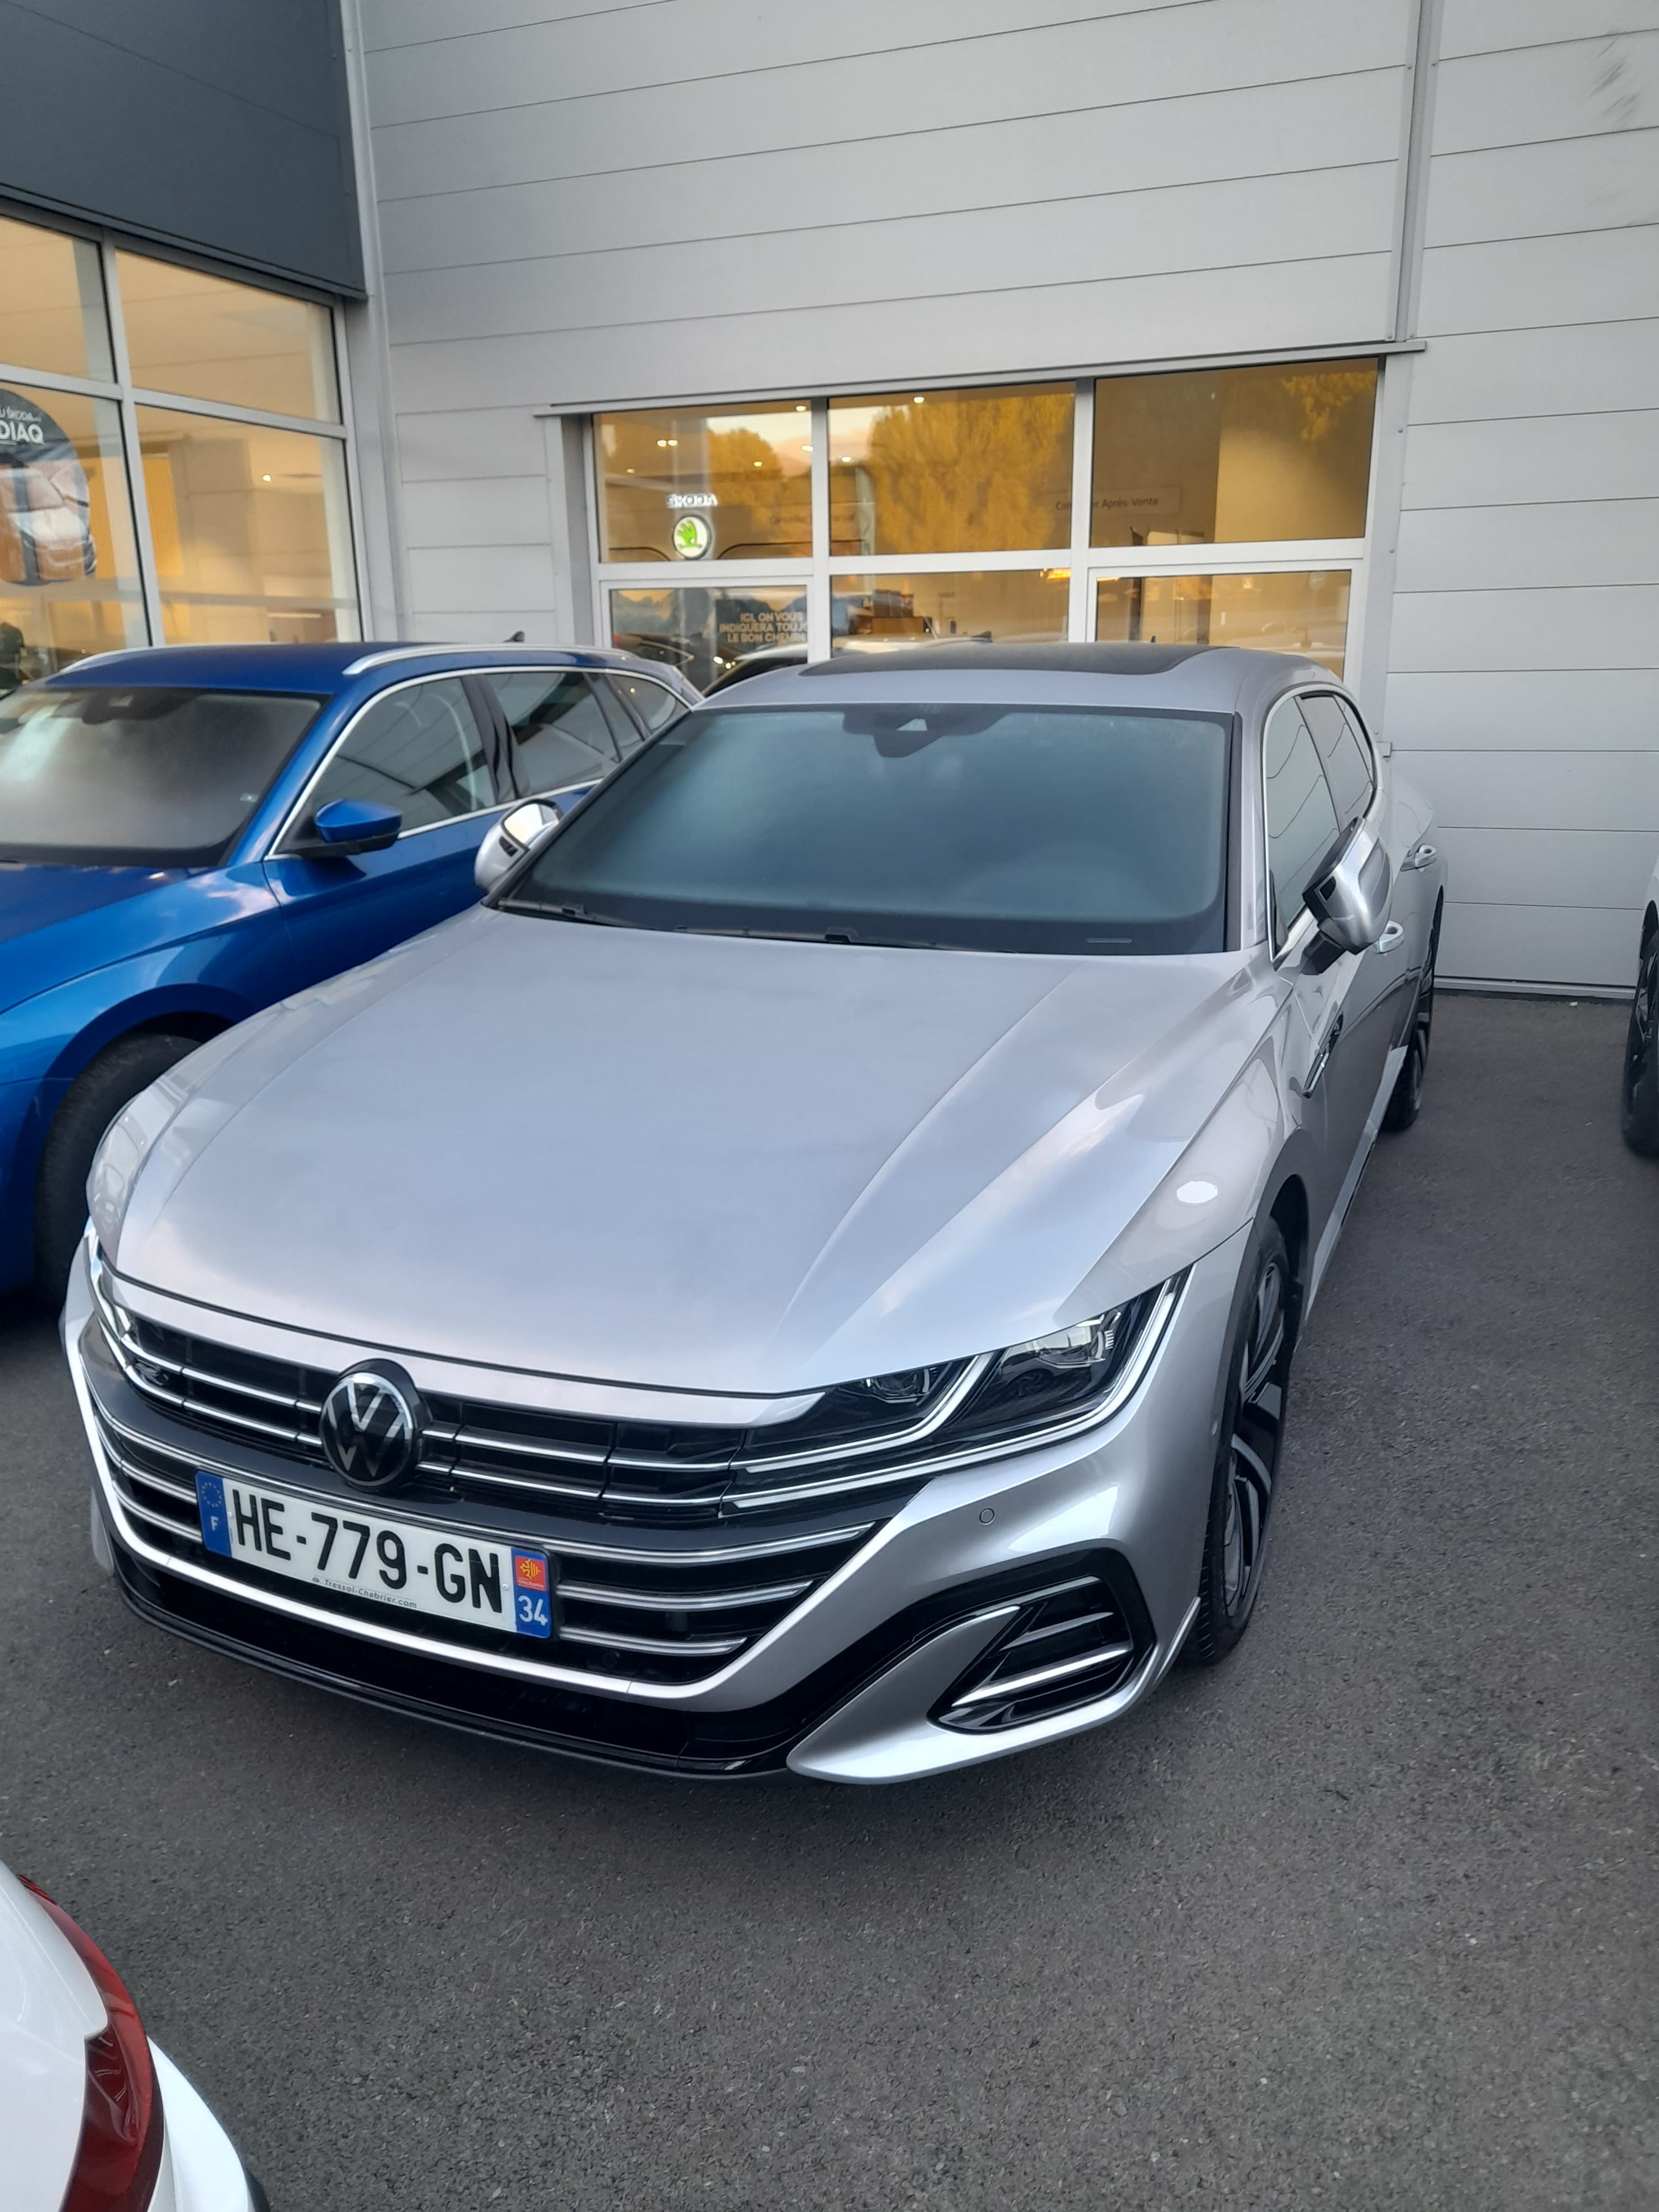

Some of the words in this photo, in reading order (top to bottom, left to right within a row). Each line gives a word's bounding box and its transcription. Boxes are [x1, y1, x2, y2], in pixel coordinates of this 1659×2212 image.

[210, 1516, 220, 1532] F
[232, 1489, 503, 1614] HE-779-GN
[324, 1579, 417, 1608] Tressol-Chabrier.com
[518, 1595, 548, 1626] 34
